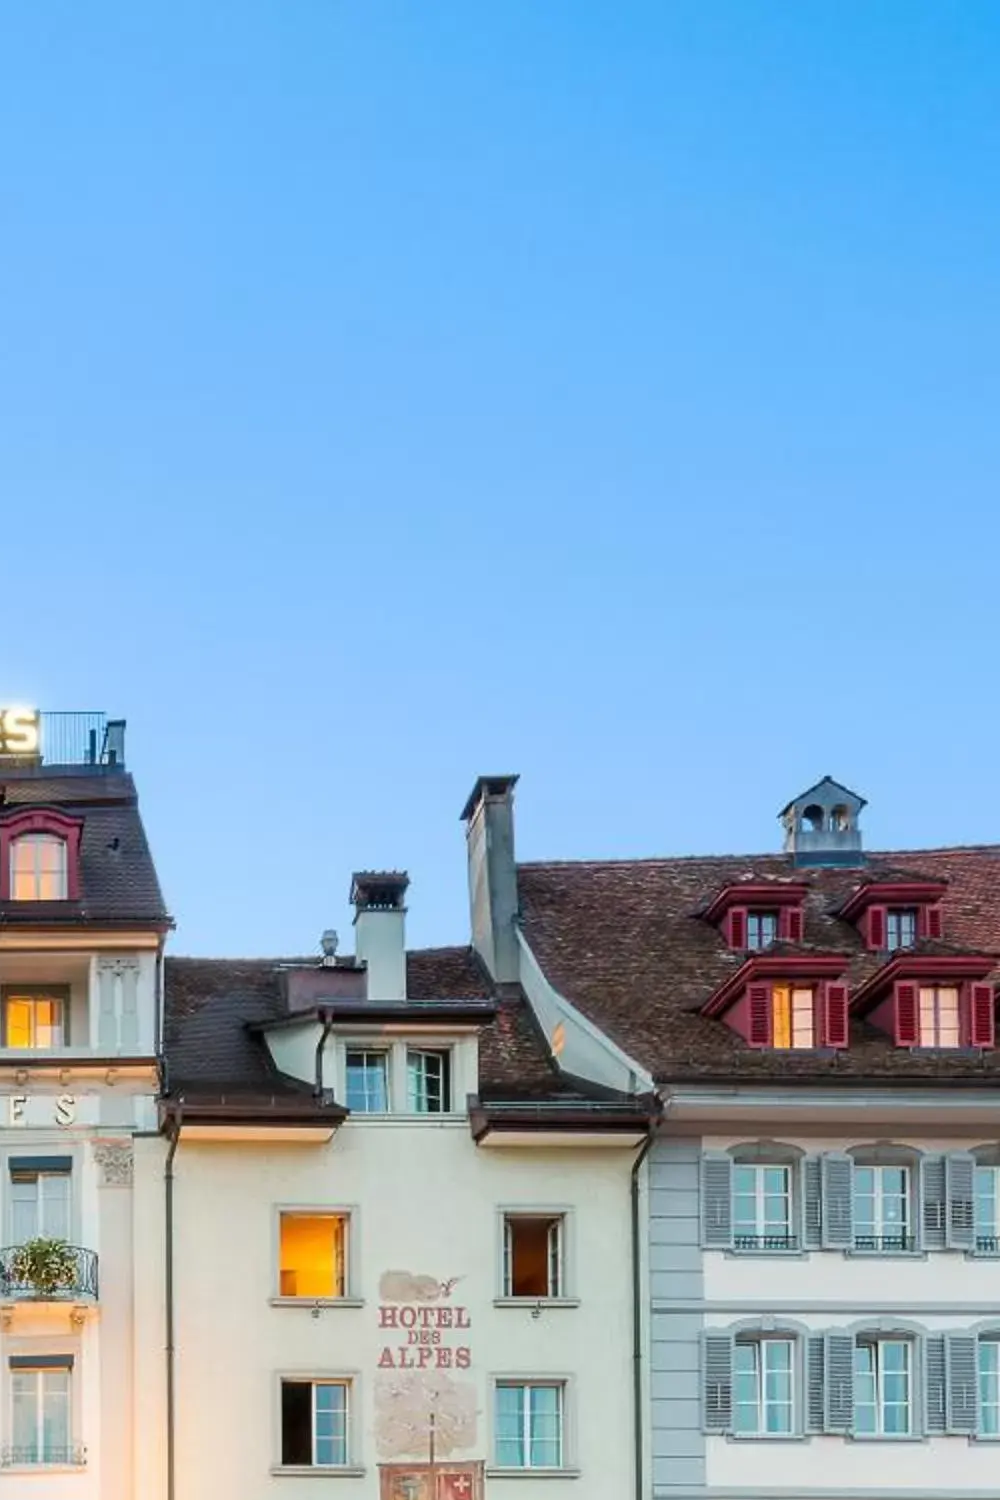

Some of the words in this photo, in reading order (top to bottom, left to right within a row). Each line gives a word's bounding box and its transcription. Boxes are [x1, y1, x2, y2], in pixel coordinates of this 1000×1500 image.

[378, 1306, 471, 1329] HOTEL
[407, 1330, 441, 1345] DES
[377, 1346, 471, 1369] ALPES
